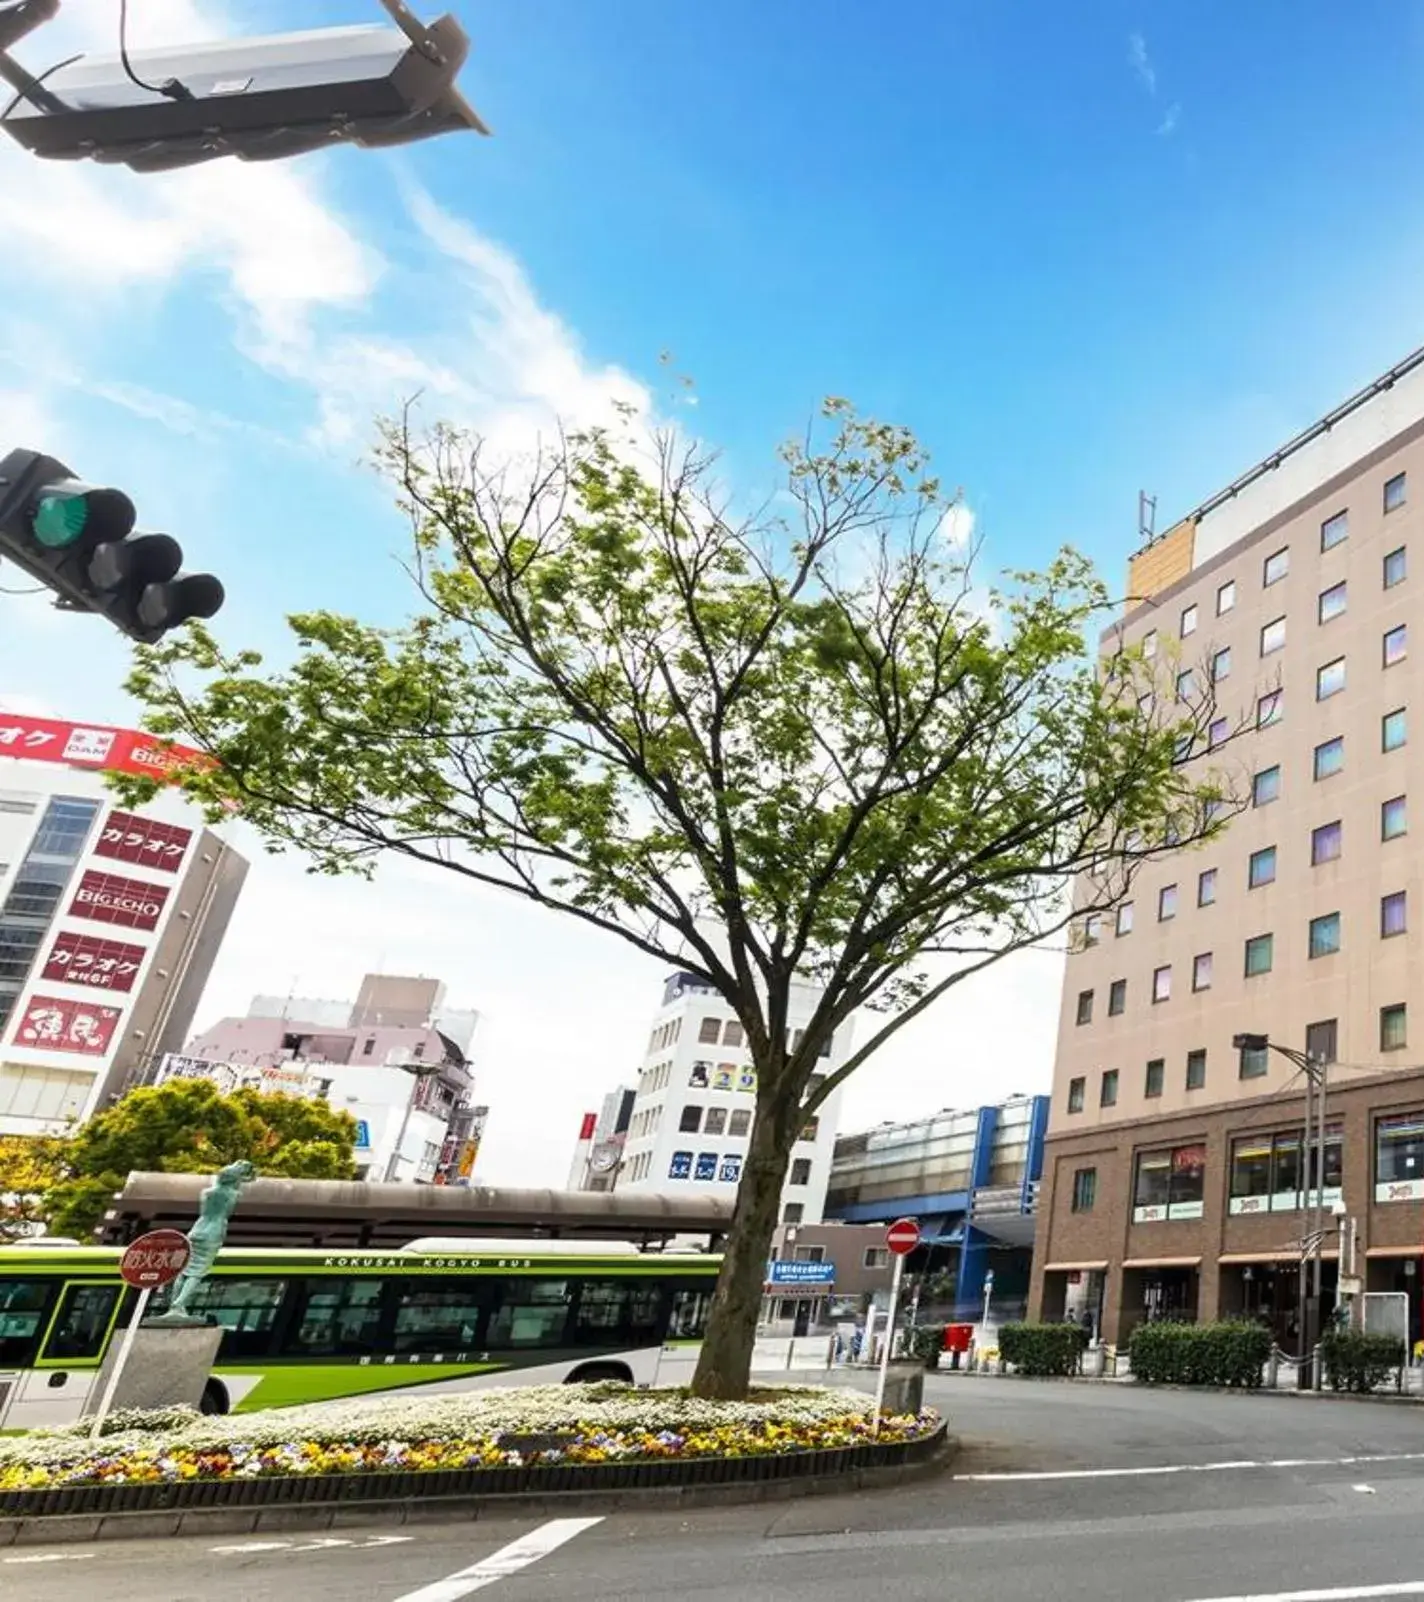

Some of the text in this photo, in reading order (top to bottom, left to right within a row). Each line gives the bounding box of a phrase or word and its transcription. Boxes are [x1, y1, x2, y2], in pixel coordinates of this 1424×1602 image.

[101, 828, 185, 856] カラオケ
[77, 889, 161, 916] BIG ECHO
[50, 949, 140, 974] カラオケ
[324, 1257, 532, 1268] KOKUSAI KOGYO BUS
